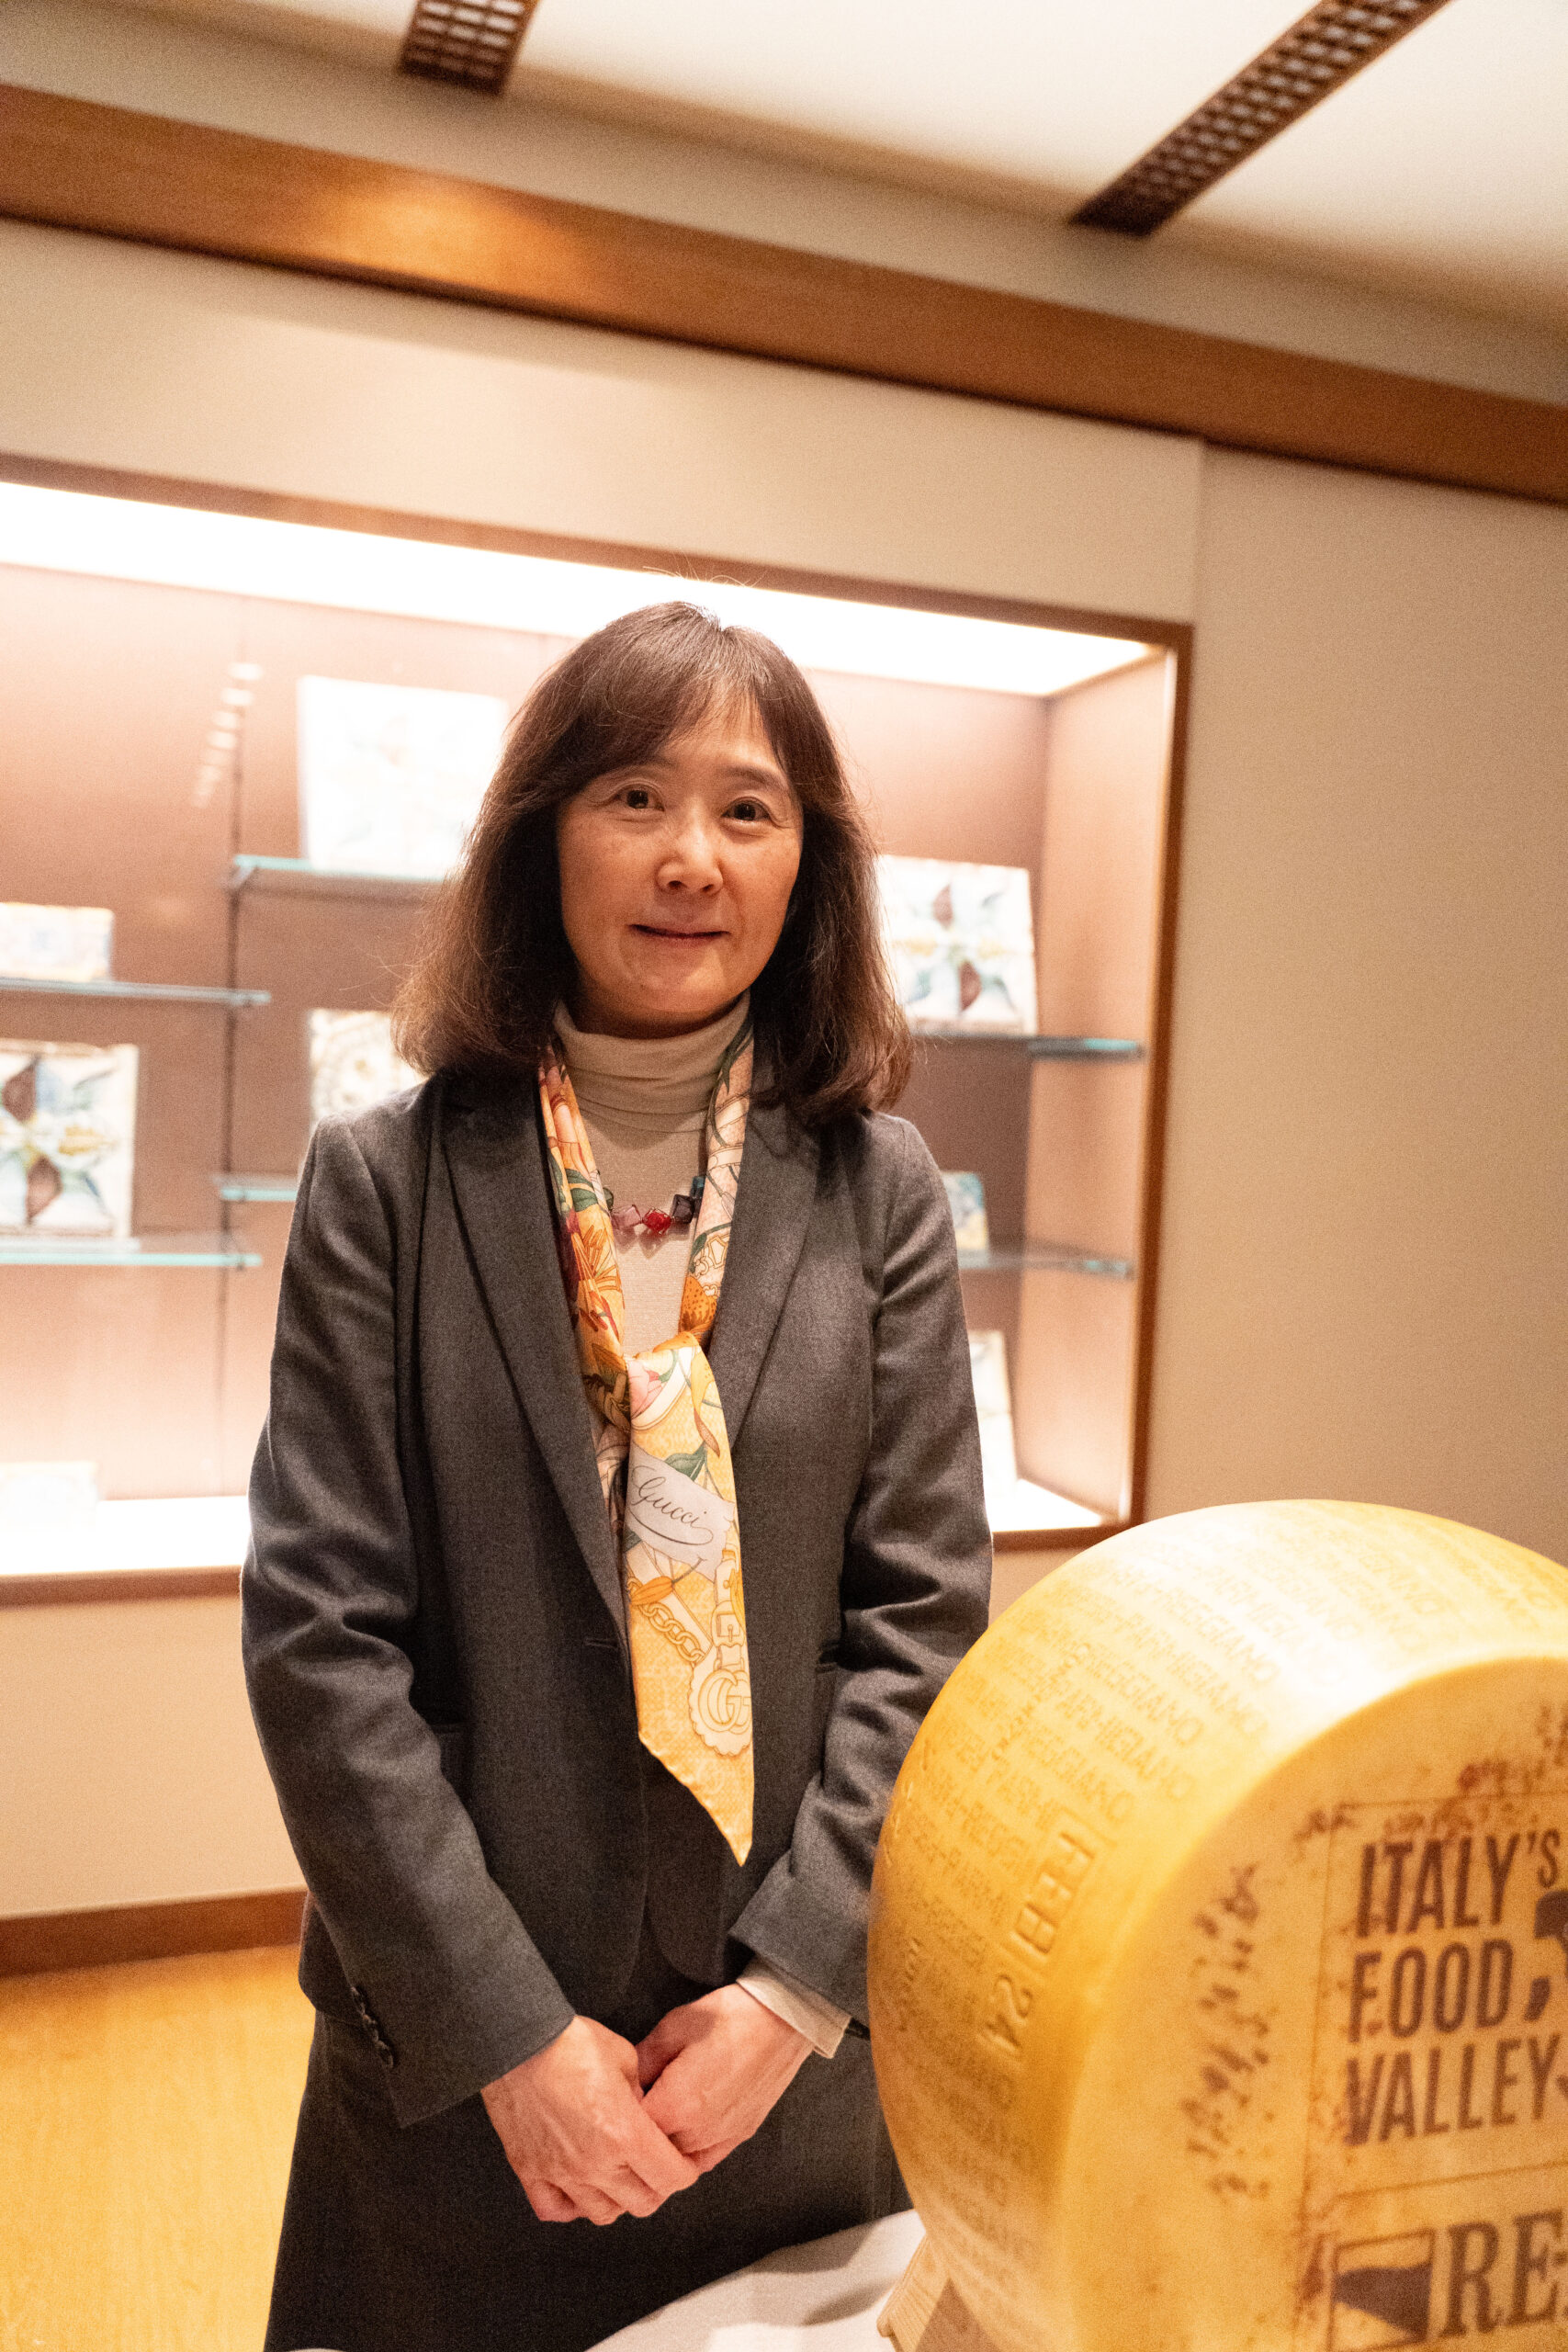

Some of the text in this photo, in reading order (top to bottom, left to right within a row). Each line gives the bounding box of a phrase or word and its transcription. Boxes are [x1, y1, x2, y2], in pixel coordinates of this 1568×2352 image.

[630, 1475, 714, 1544] Gucci
[1013, 1831, 1095, 1955] FEB
[1357, 1827, 1562, 1939] ITALY'S
[985, 1973, 1034, 2050] 24
[1348, 1939, 1515, 2043] FOOD
[1344, 2033, 1562, 2146] VALLEY
[1438, 2208, 1568, 2338] RE
